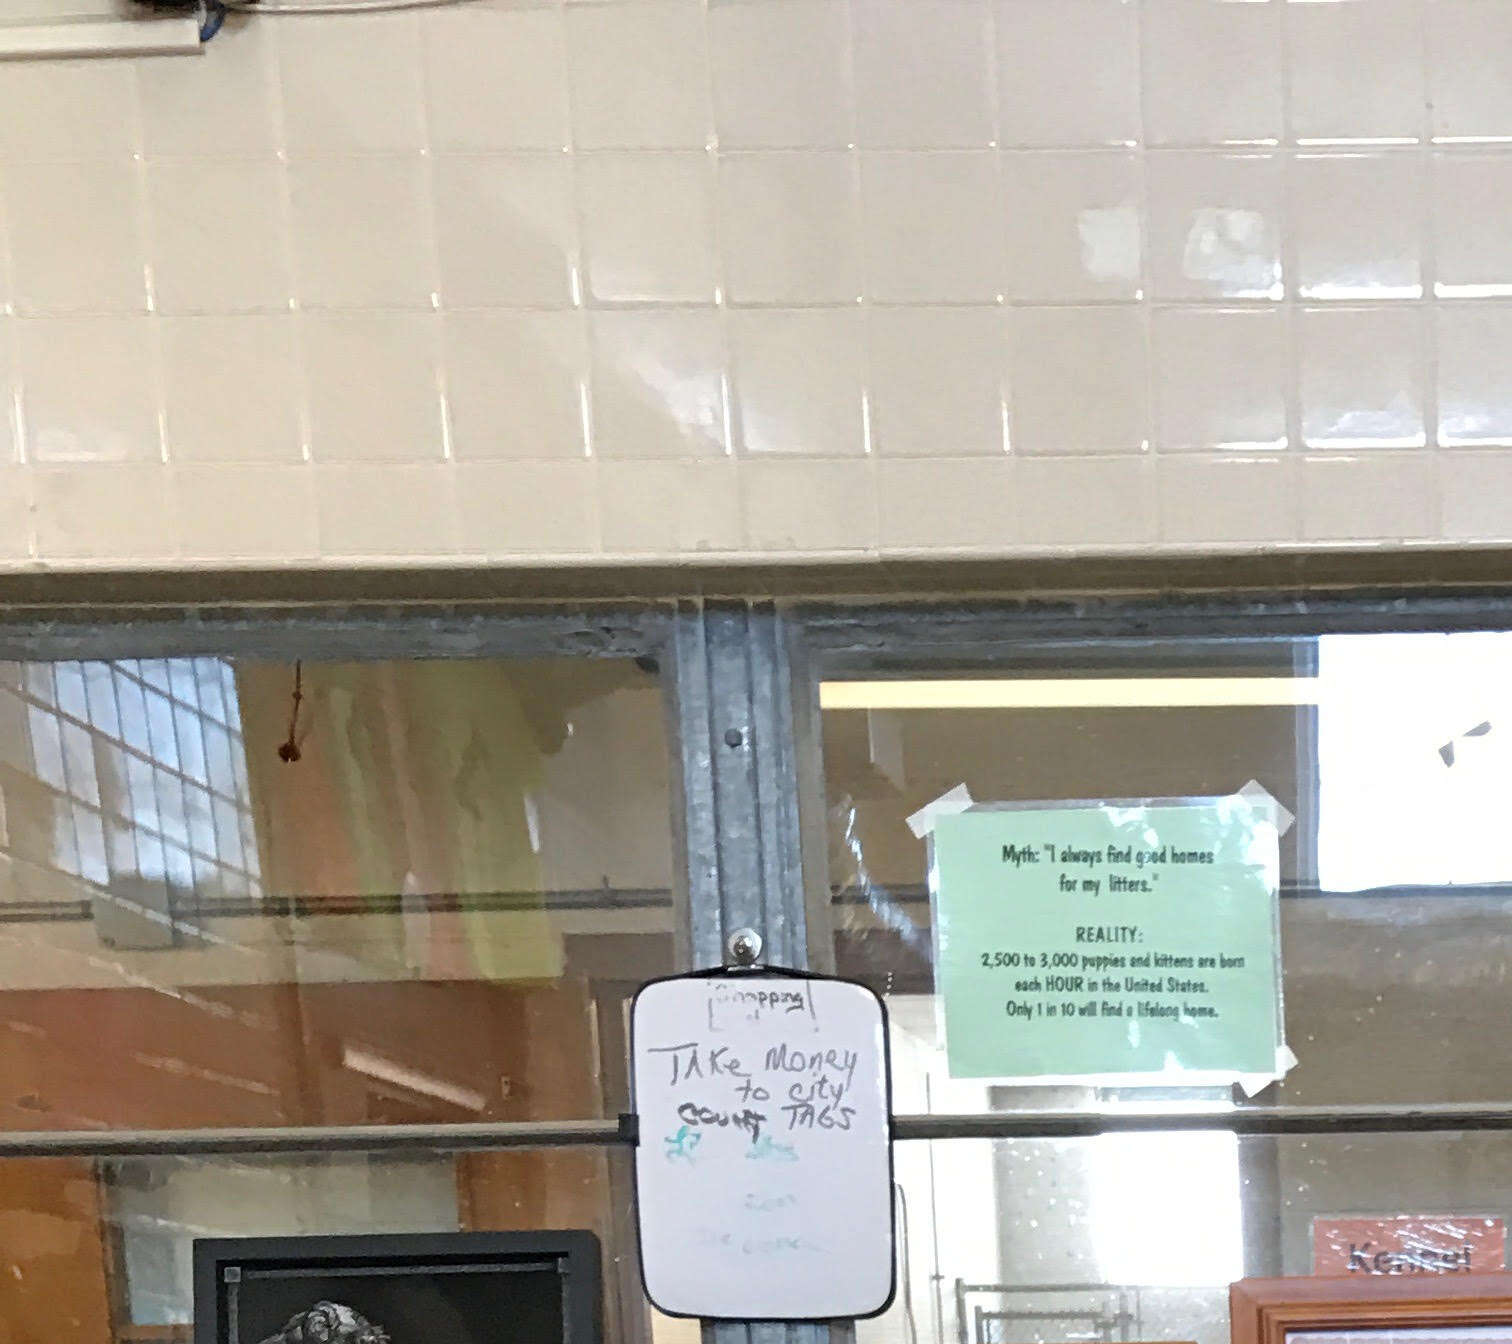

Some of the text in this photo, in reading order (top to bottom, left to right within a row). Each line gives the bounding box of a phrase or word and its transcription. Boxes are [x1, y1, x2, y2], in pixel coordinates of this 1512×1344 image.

[1002, 843, 1040, 868] Myth:
[1061, 845, 1102, 868] always
[1107, 844, 1132, 863] find
[1136, 845, 1166, 868] good
[1171, 845, 1214, 864] homes
[1059, 873, 1077, 892] for
[1082, 879, 1100, 896] my
[1076, 926, 1143, 944] REALITY:
[981, 952, 1245, 972] 2,500 to 3,000 puppies and kittens are born
[1015, 975, 1209, 993] each HOUR in the United States.
[1006, 1000, 1032, 1021] Only
[1037, 1001, 1042, 1017] 1
[1046, 1001, 1057, 1017] in
[1061, 1001, 1075, 1017] 10
[1078, 1001, 1097, 1017] will
[1101, 1000, 1122, 1017] find
[1137, 1001, 1179, 1021] lifelong
[735, 1078, 770, 1102] to
[781, 1103, 856, 1130] TAGS
